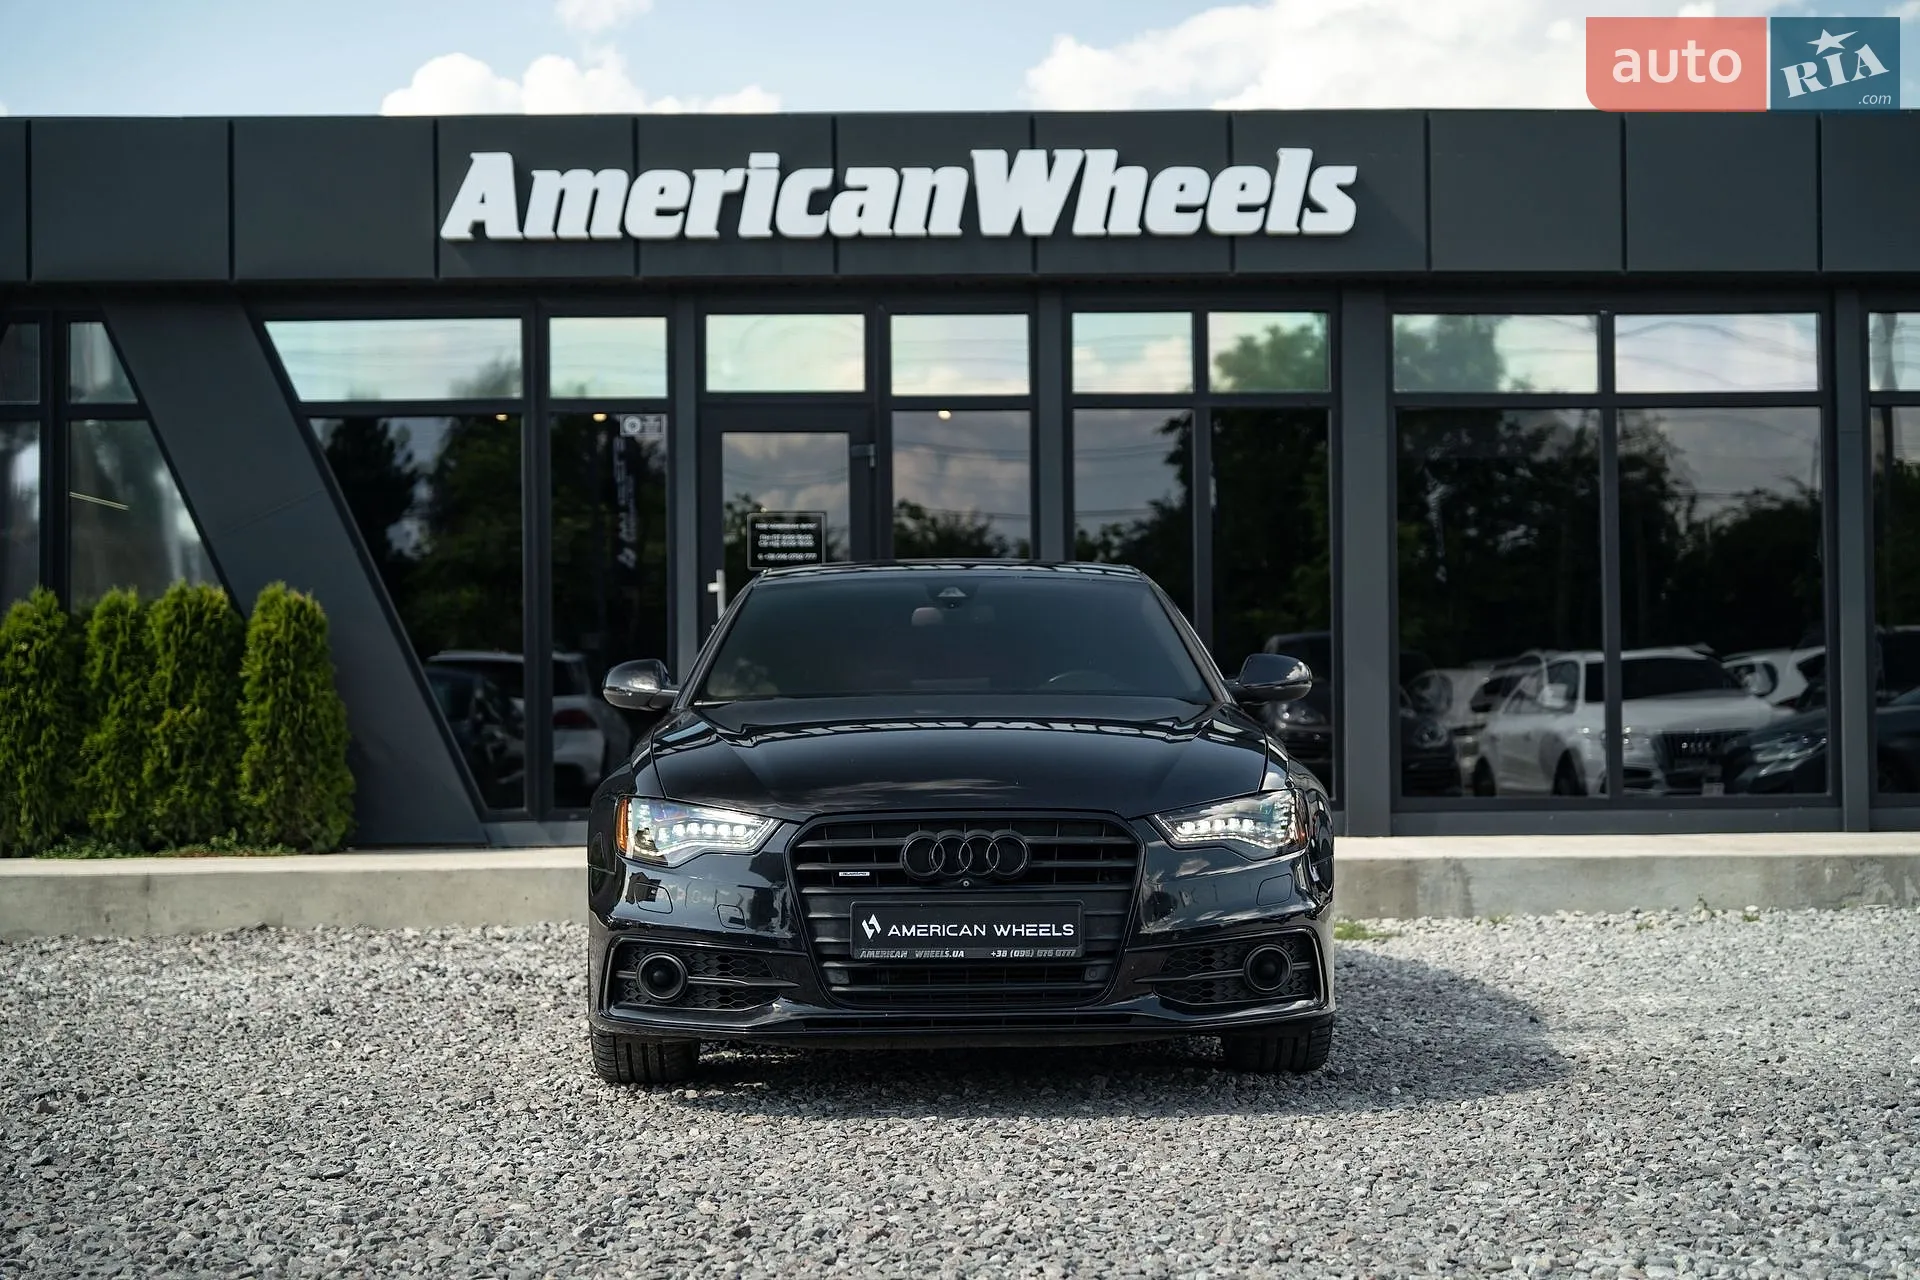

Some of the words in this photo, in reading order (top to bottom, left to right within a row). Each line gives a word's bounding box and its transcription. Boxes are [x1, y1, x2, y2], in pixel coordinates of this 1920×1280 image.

[439, 147, 1359, 239] AmericanWheels
[888, 923, 986, 937] AMERICAN
[993, 923, 1075, 937] WHEELS
[860, 949, 908, 958] AMERICAN
[990, 949, 1007, 958] +38
